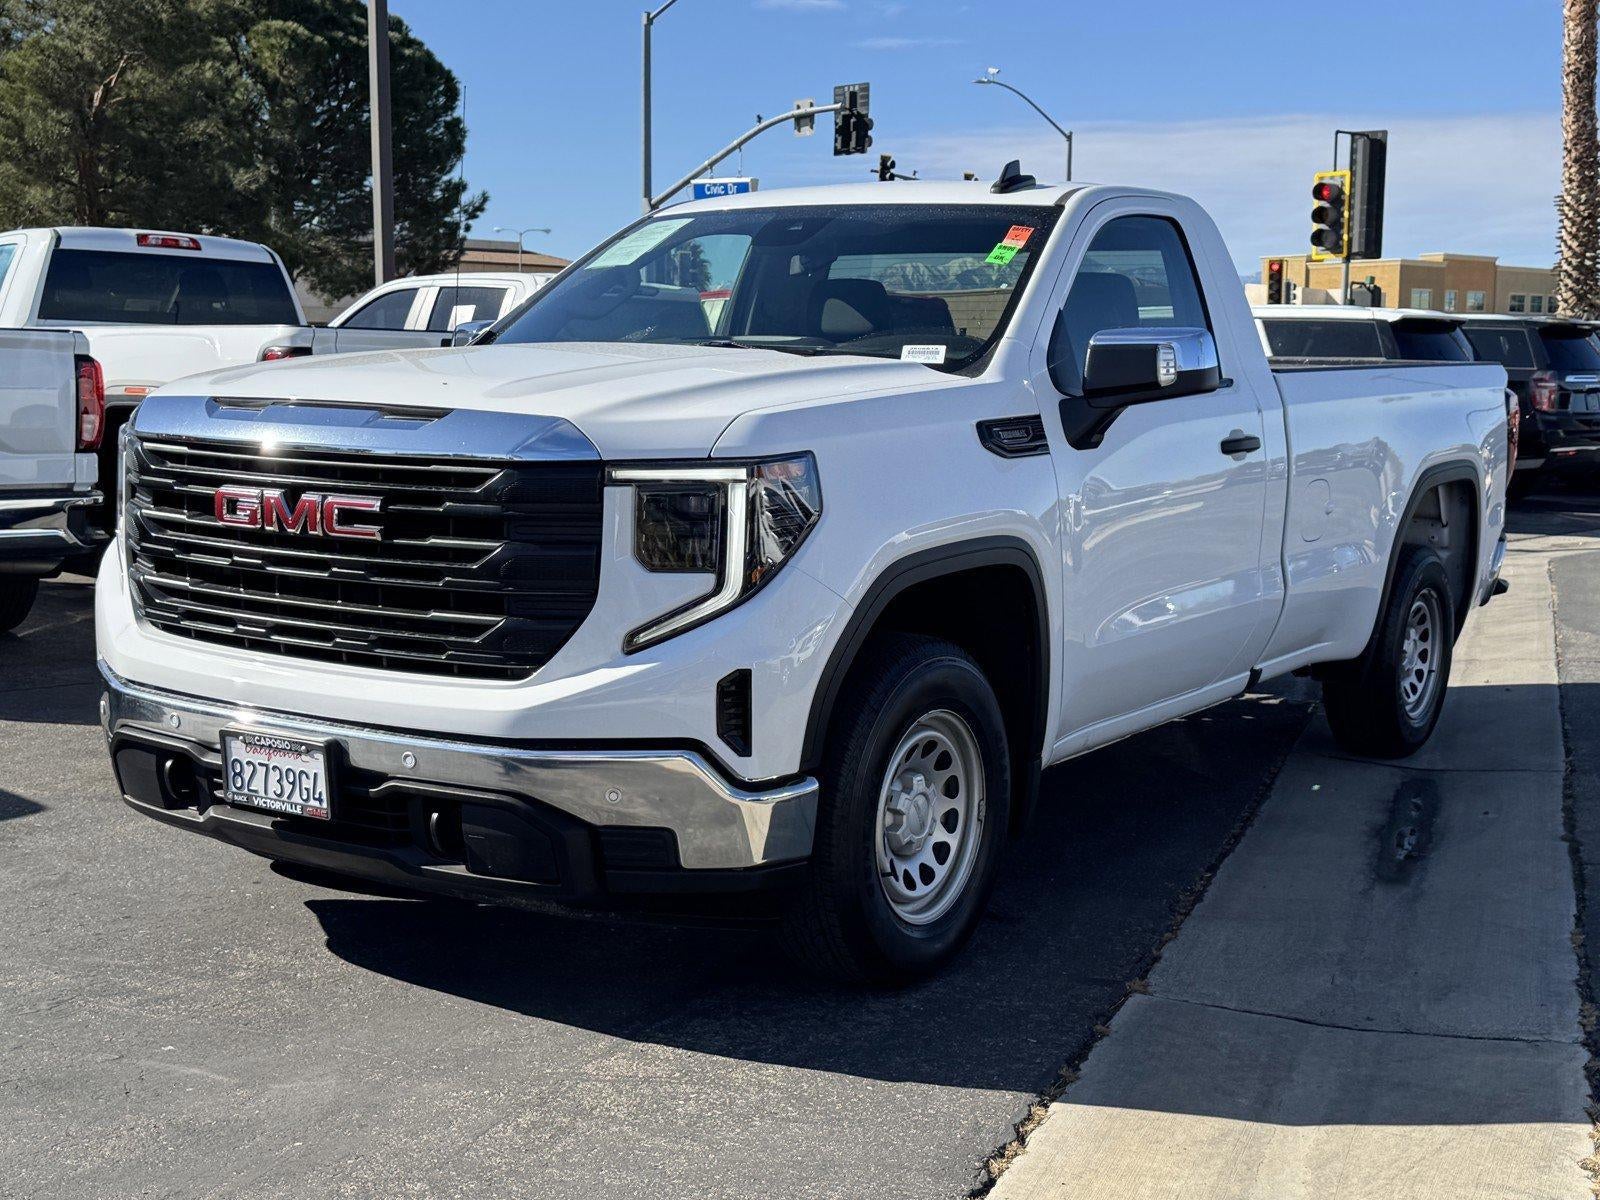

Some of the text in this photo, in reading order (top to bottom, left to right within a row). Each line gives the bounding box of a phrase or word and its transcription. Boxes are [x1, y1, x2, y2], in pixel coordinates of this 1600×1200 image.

[704, 183, 738, 195] Civic Dr
[214, 484, 384, 541] GMC
[254, 736, 291, 750] CAPOSIO
[231, 757, 324, 806] 82739G4
[252, 796, 303, 814] VICTORVILLE
